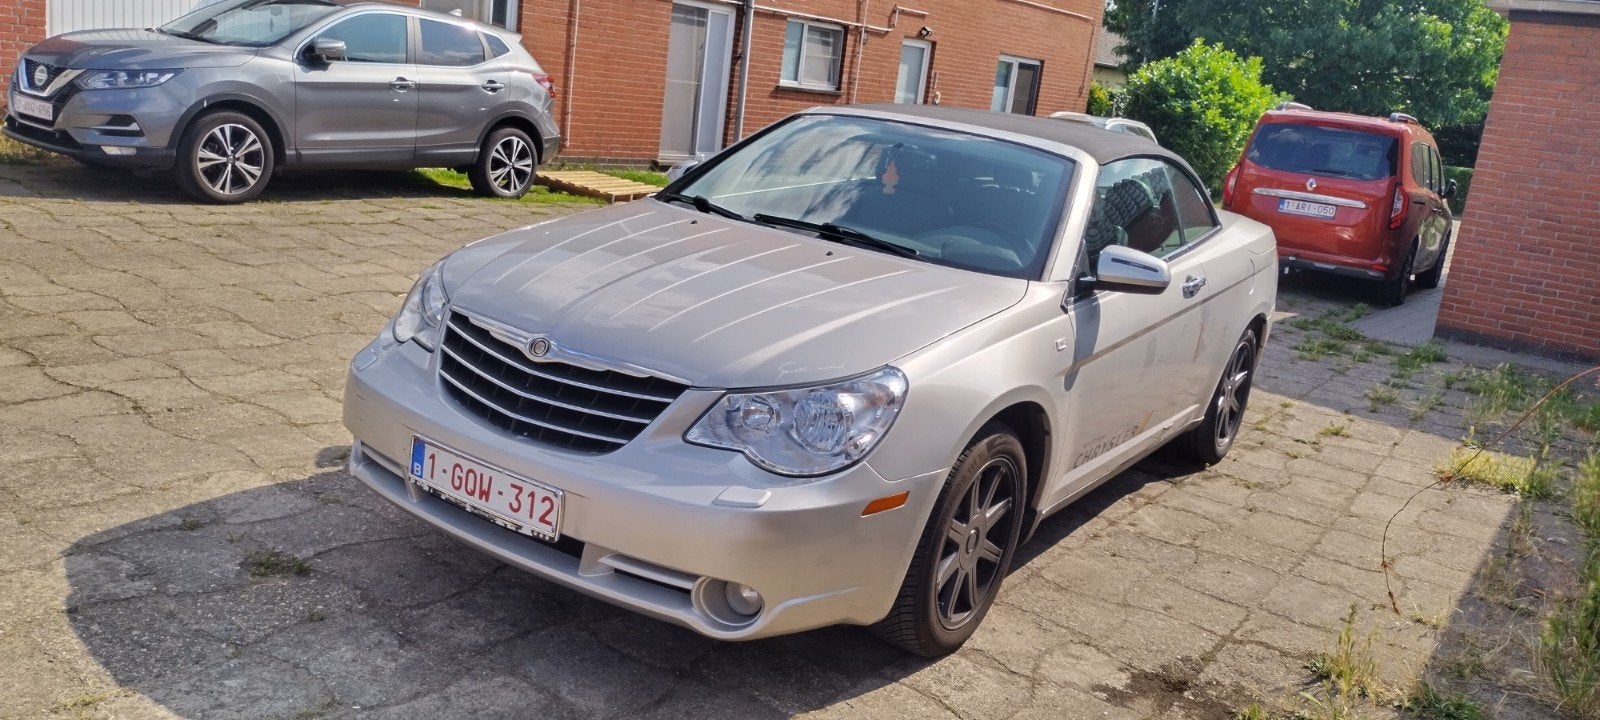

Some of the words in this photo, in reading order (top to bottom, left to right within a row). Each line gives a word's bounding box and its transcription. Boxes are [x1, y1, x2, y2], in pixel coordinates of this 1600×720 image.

[1073, 425, 1139, 469] CHRYSLER
[413, 463, 421, 475] B
[428, 453, 555, 527] 1-GQW-312
